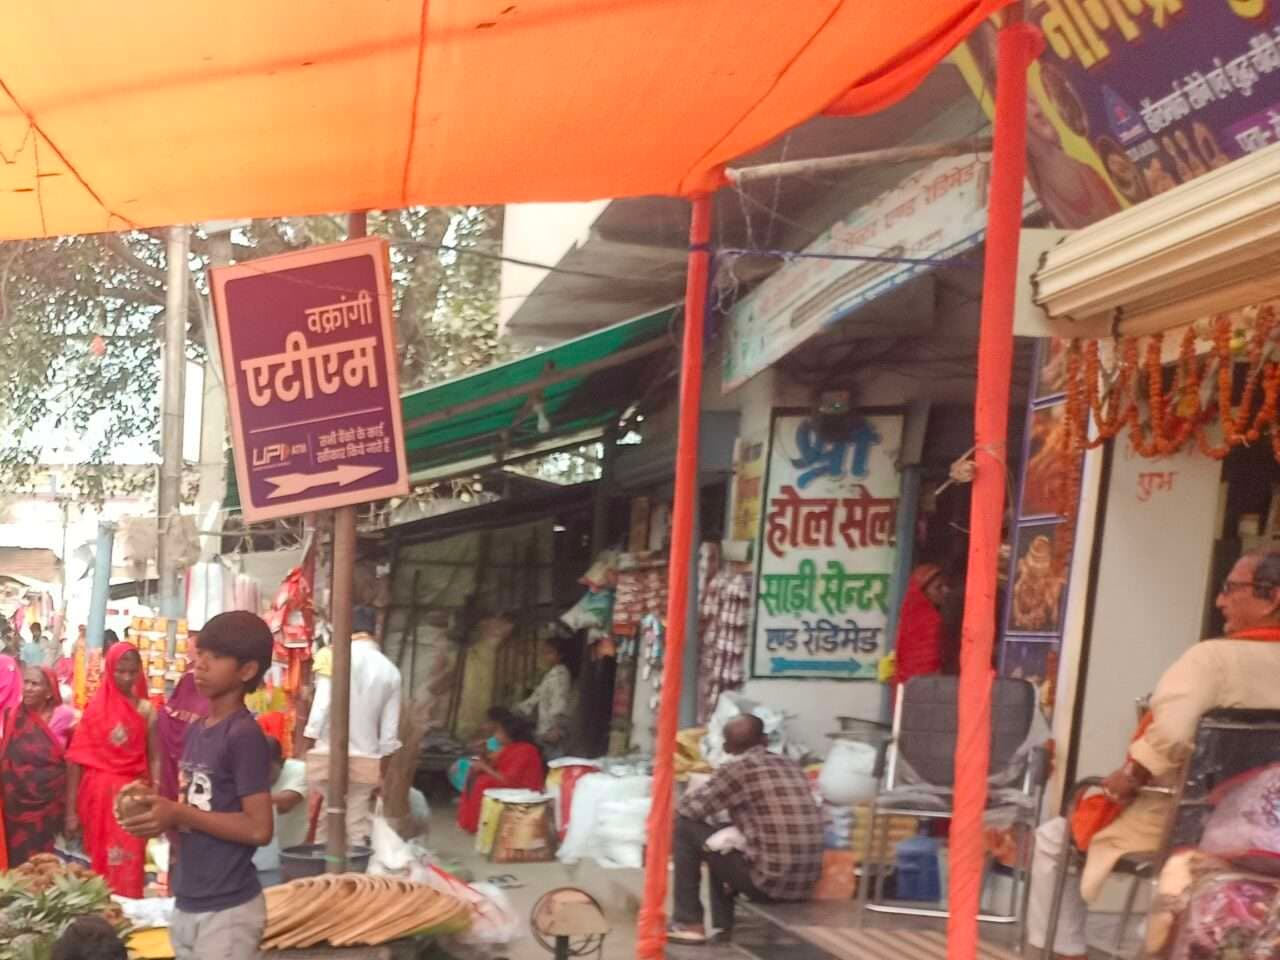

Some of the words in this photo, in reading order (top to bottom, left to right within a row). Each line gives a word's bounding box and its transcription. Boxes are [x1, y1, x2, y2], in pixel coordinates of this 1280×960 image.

[304, 289, 373, 335] वक्रांगी
[240, 331, 379, 407] एटीएम
[252, 443, 287, 467] UPI
[767, 485, 836, 557] होल
[839, 484, 897, 549] सेल
[759, 559, 817, 618] साड़ी
[819, 560, 890, 616] सेन्टर
